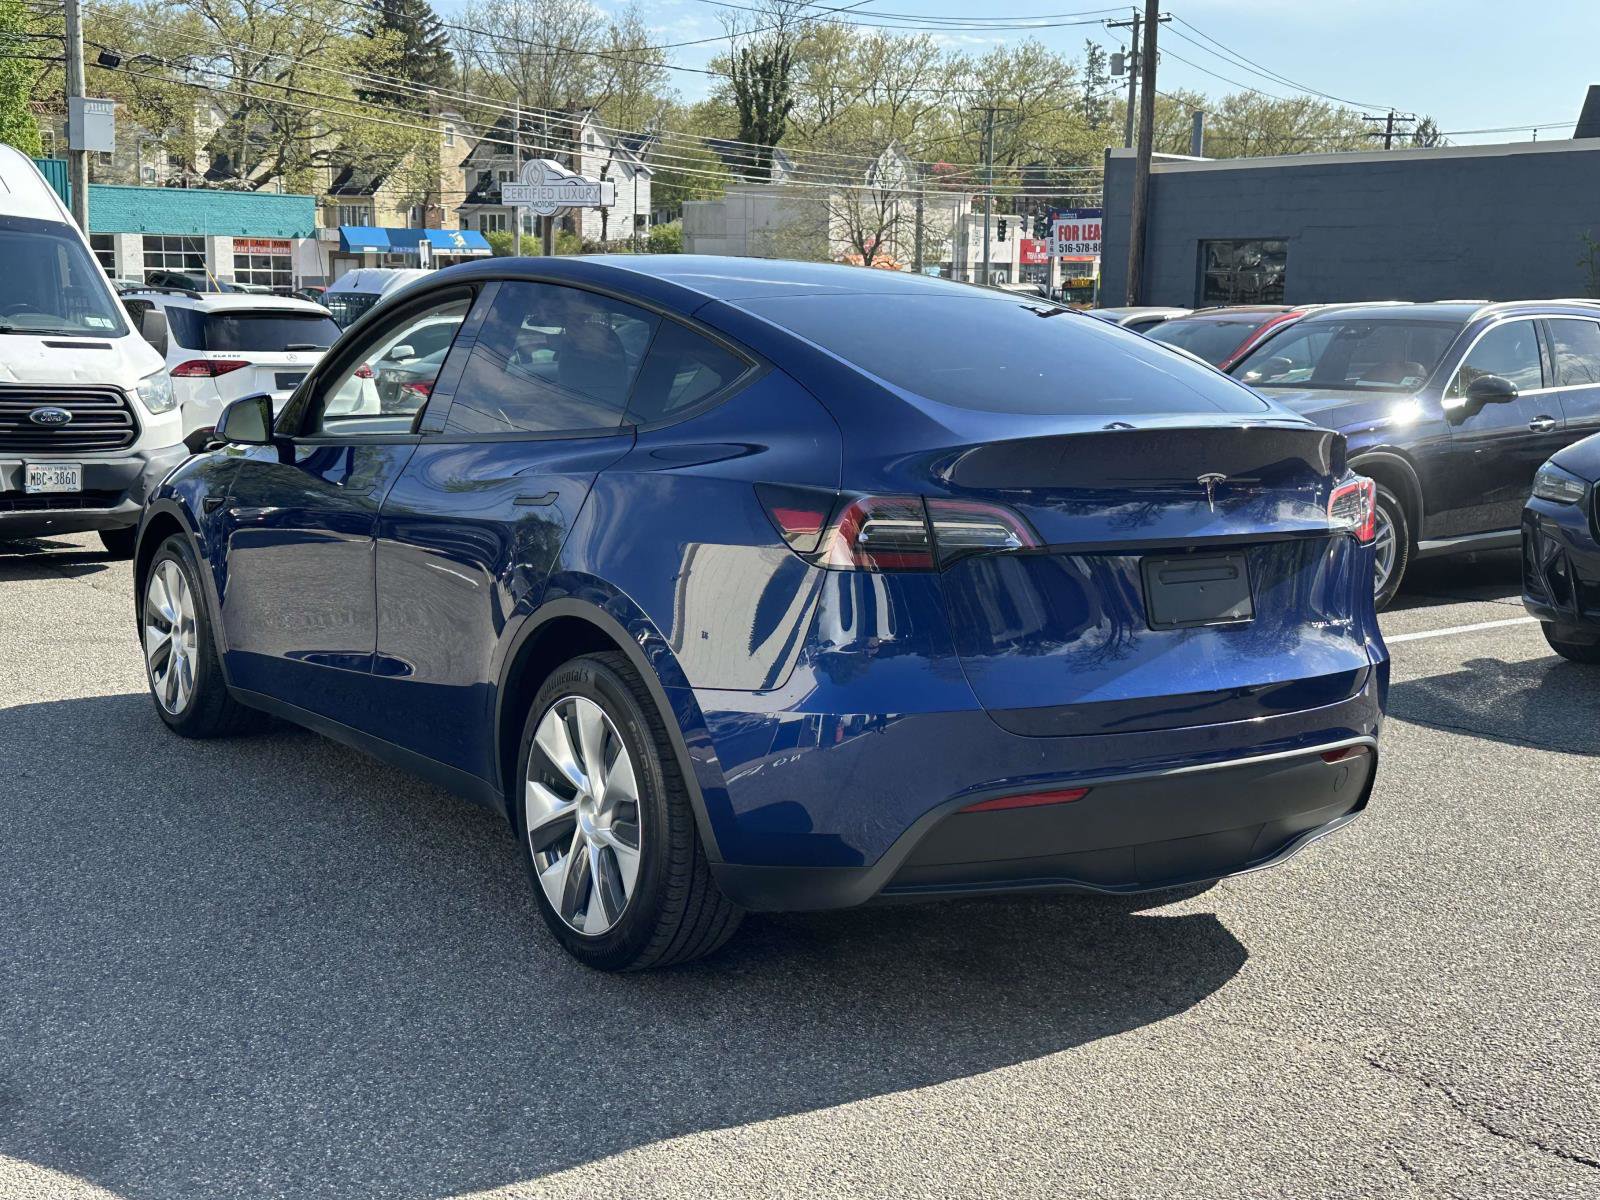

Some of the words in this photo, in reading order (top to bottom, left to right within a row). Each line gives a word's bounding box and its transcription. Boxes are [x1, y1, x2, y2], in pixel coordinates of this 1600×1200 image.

[503, 187, 554, 200] CERTIFIED
[559, 187, 599, 200] LUXURY
[1058, 225, 1079, 240] FOR
[1082, 224, 1100, 240] LEA
[1059, 243, 1102, 253] 516-578-88
[40, 411, 63, 421] Ford
